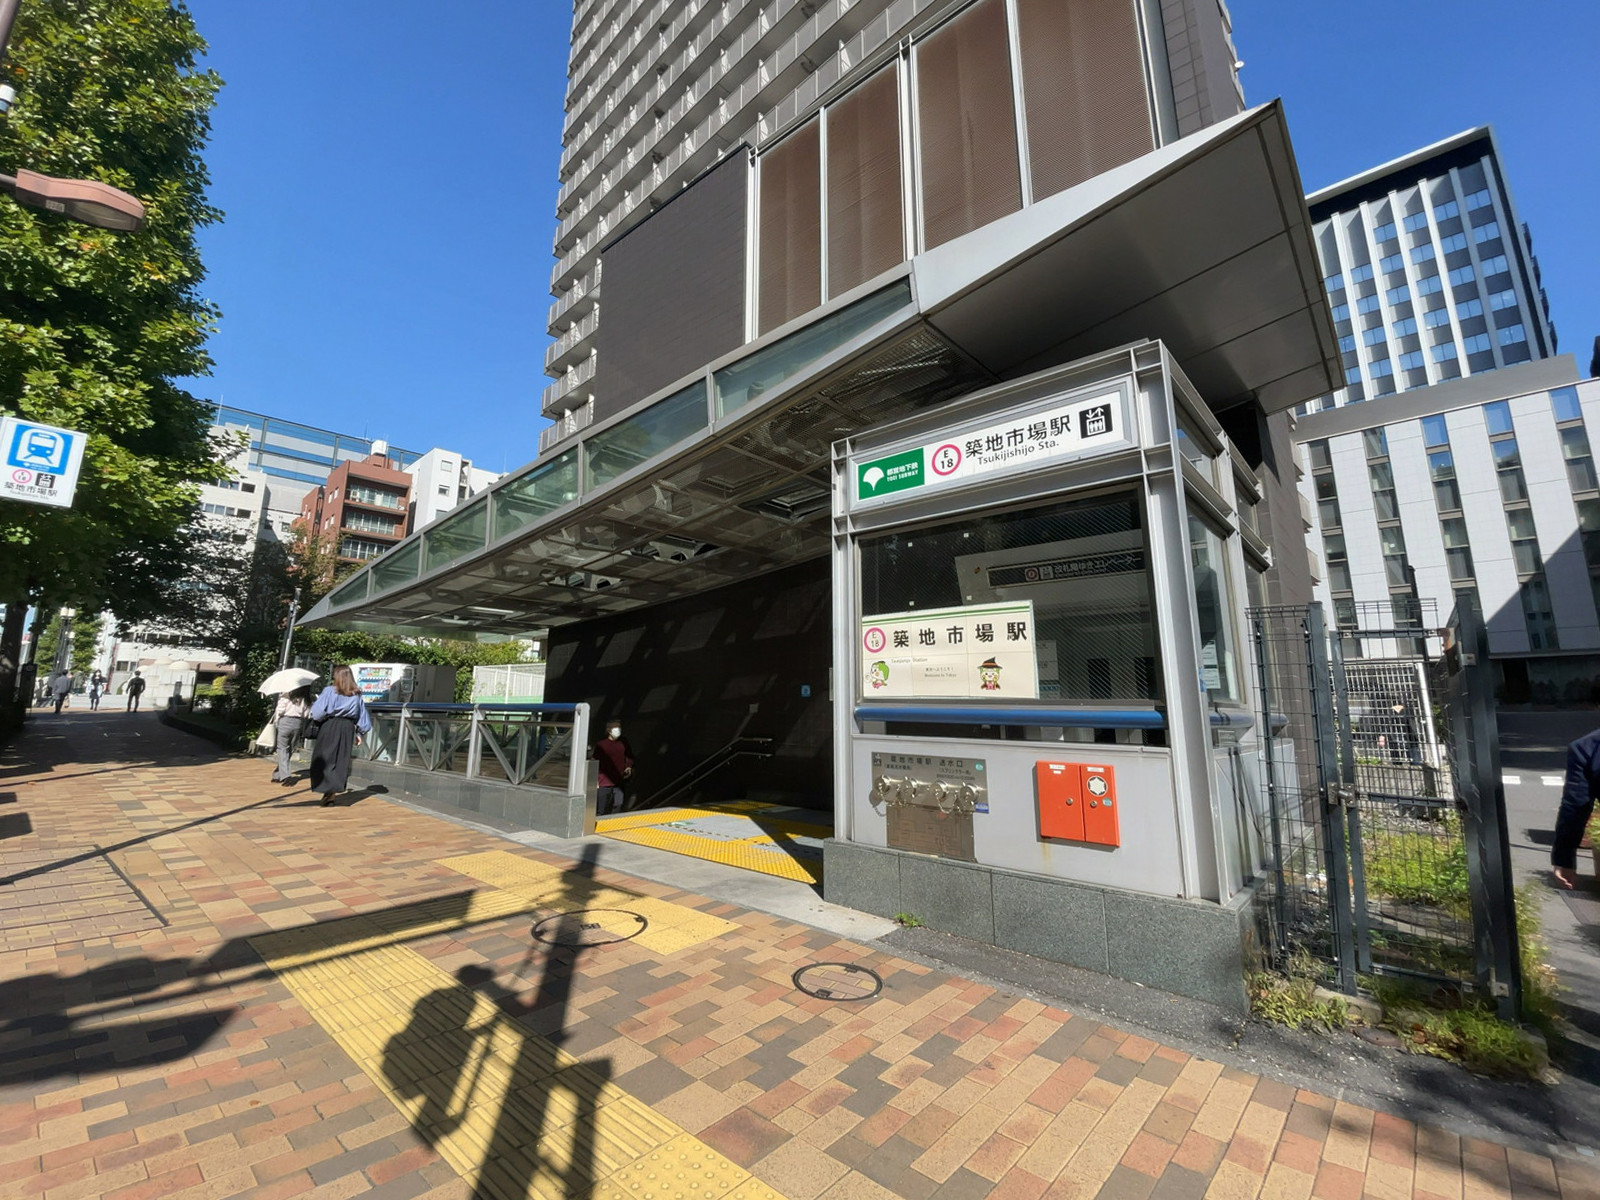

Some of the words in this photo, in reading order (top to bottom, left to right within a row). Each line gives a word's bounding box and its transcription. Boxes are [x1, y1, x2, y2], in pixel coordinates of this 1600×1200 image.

[965, 414, 1071, 459] 築地市場駅
[943, 449, 949, 458] E
[978, 446, 1035, 466] Tsukijishijo
[1038, 440, 1060, 451] Sta.
[886, 462, 919, 476] 都営地下鉄
[940, 458, 954, 470] 18
[898, 470, 919, 480] SUBWAY
[872, 631, 877, 639] E
[893, 622, 1028, 648] 築地市場駅
[871, 639, 880, 648] 18
